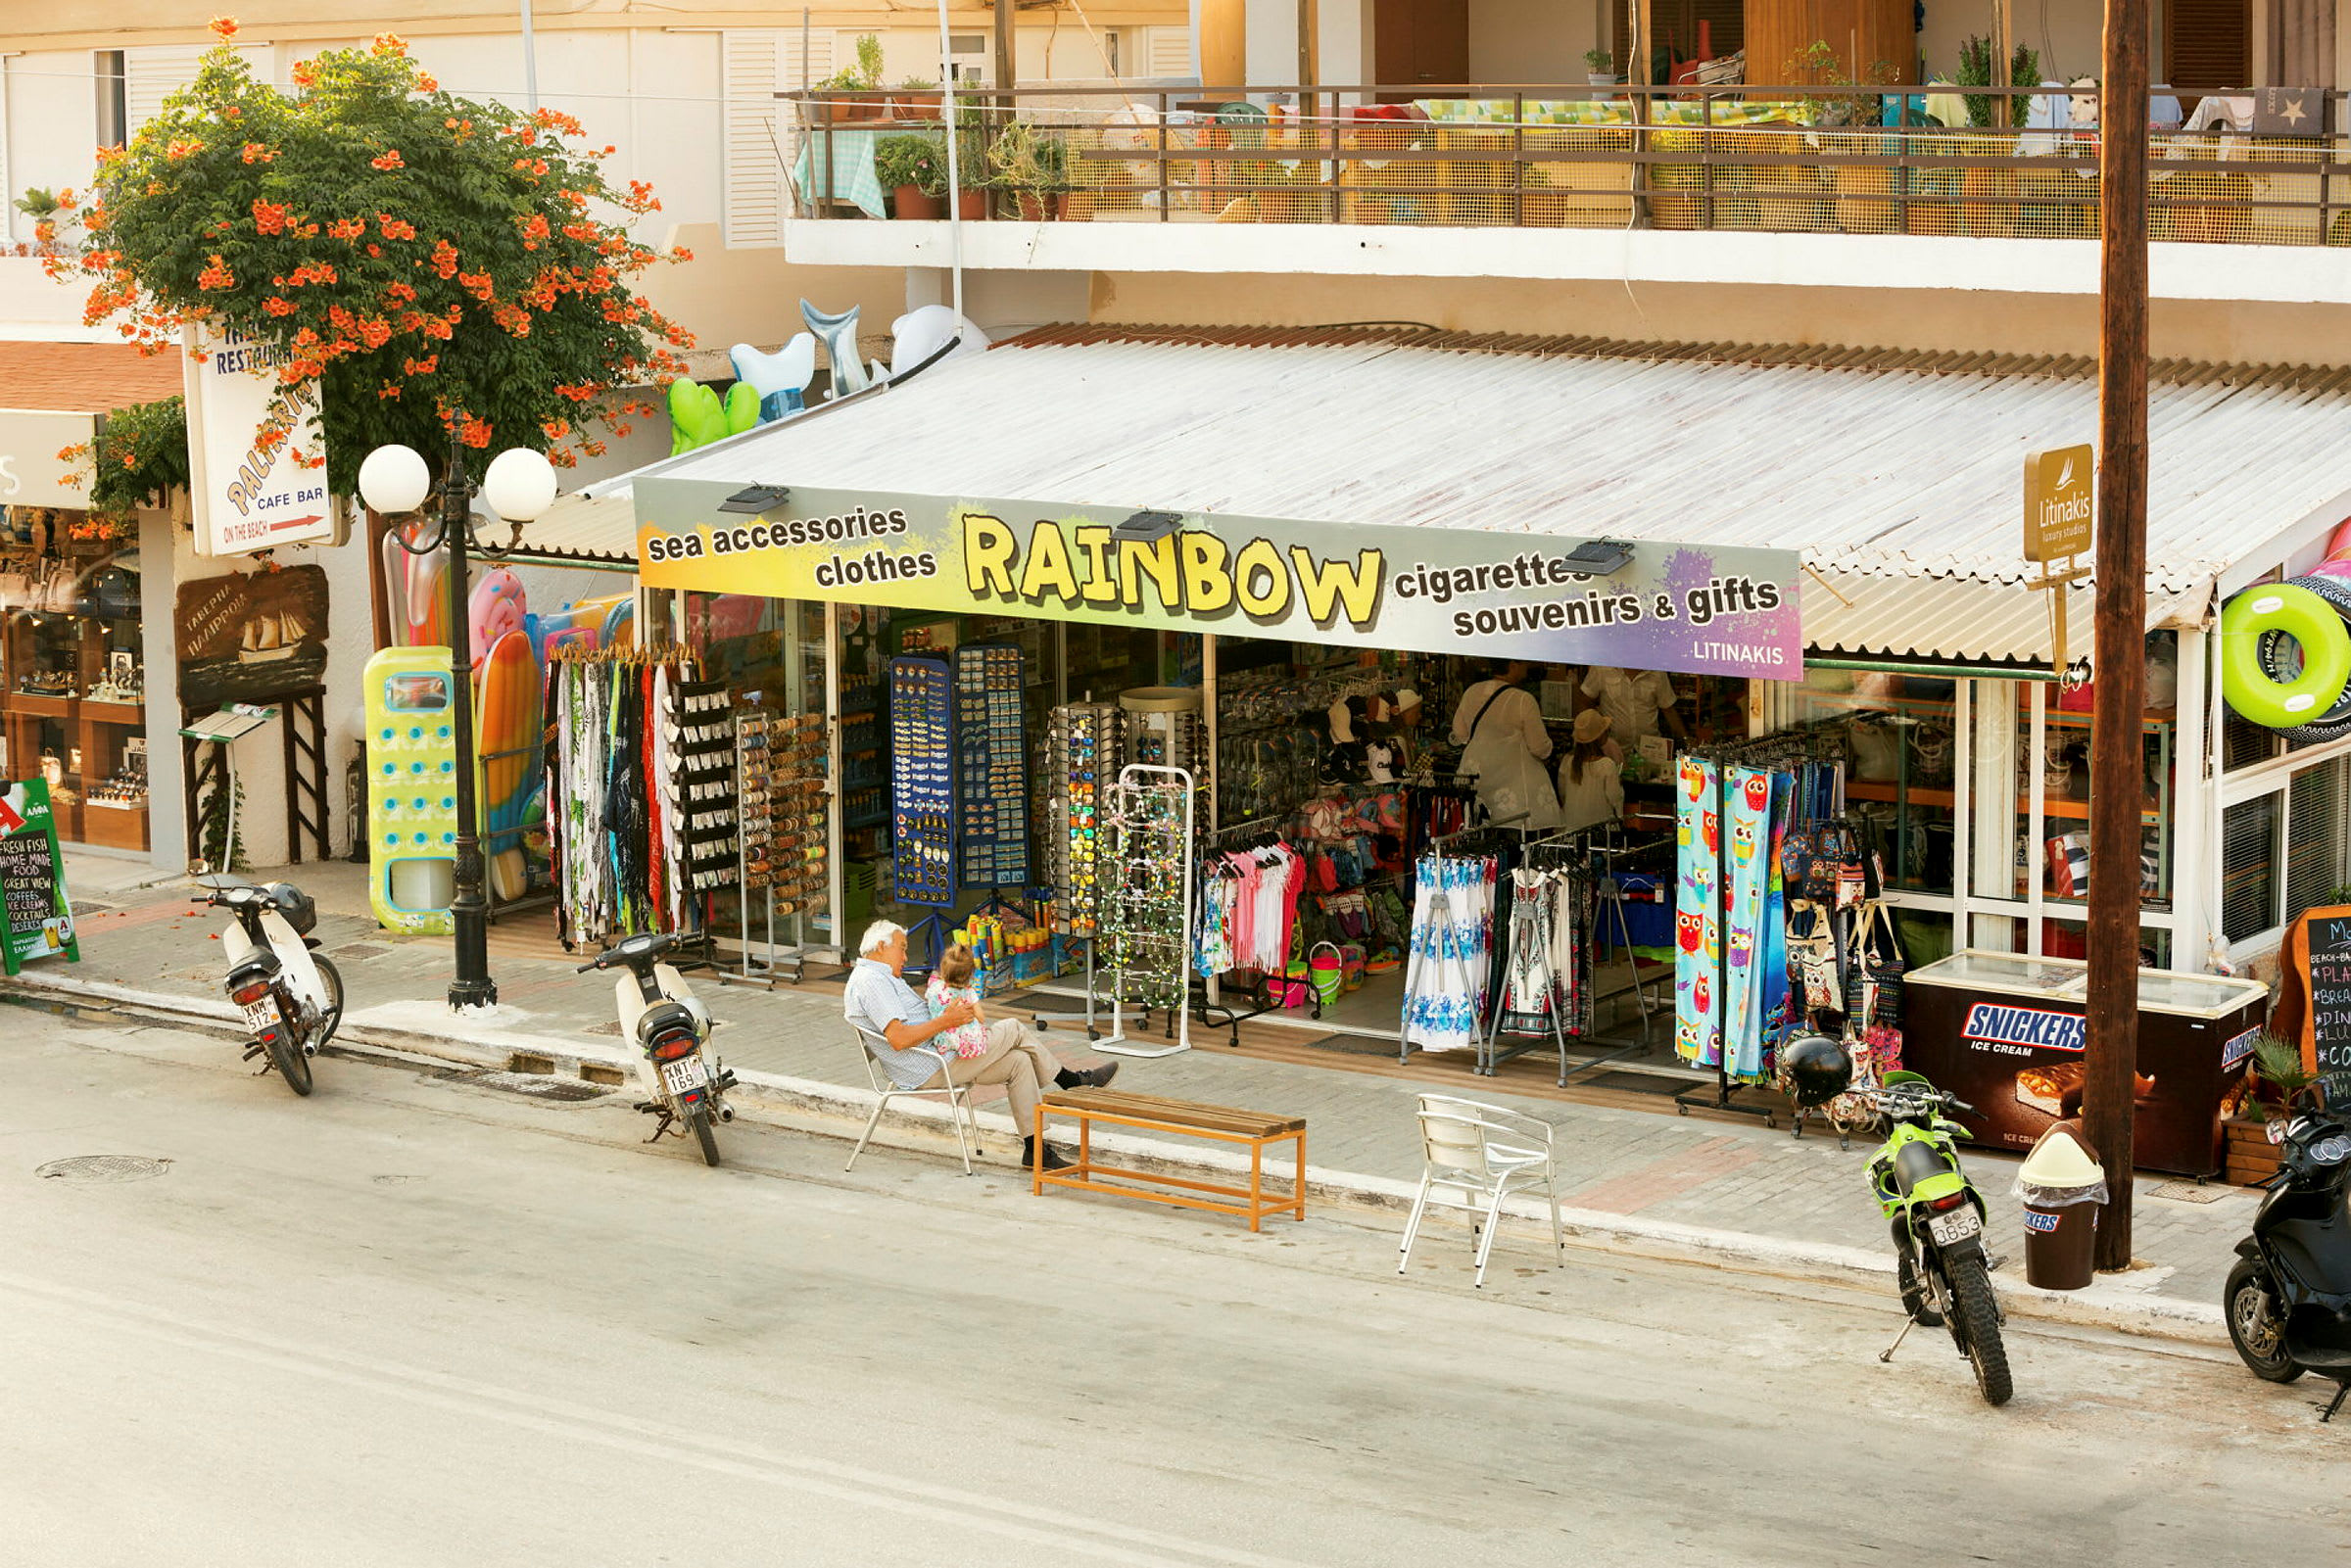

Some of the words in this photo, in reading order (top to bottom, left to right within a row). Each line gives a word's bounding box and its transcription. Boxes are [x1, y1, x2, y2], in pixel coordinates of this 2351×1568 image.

[258, 494, 290, 509] CAFE
[297, 488, 323, 502] BAR
[2039, 491, 2090, 528] Litinakis
[248, 520, 268, 540] BEACH
[648, 535, 703, 561] sea
[713, 507, 907, 553] accessories
[815, 550, 936, 588] clothes
[962, 512, 1383, 630] RAINBOW
[1454, 592, 1642, 637] souvenirs
[1655, 594, 1676, 618] &
[1688, 578, 1780, 623] gifts
[1693, 640, 1785, 665] LITINAKIS
[26, 837, 48, 852] FISH
[0, 854, 26, 868] HOME
[28, 852, 52, 867] MADE
[13, 865, 40, 877] FOOD
[4, 877, 29, 890] GREAT
[30, 877, 51, 889] VIEW
[6, 890, 40, 901] COFFEES
[9, 908, 51, 923] COCKTAILS
[249, 1012, 270, 1030] 512
[1969, 1005, 2087, 1049] SNICKERS
[1971, 1040, 1990, 1051] ICE
[1992, 1044, 2033, 1057] CREAM
[664, 1061, 689, 1079] XNT
[672, 1073, 695, 1091] 169
